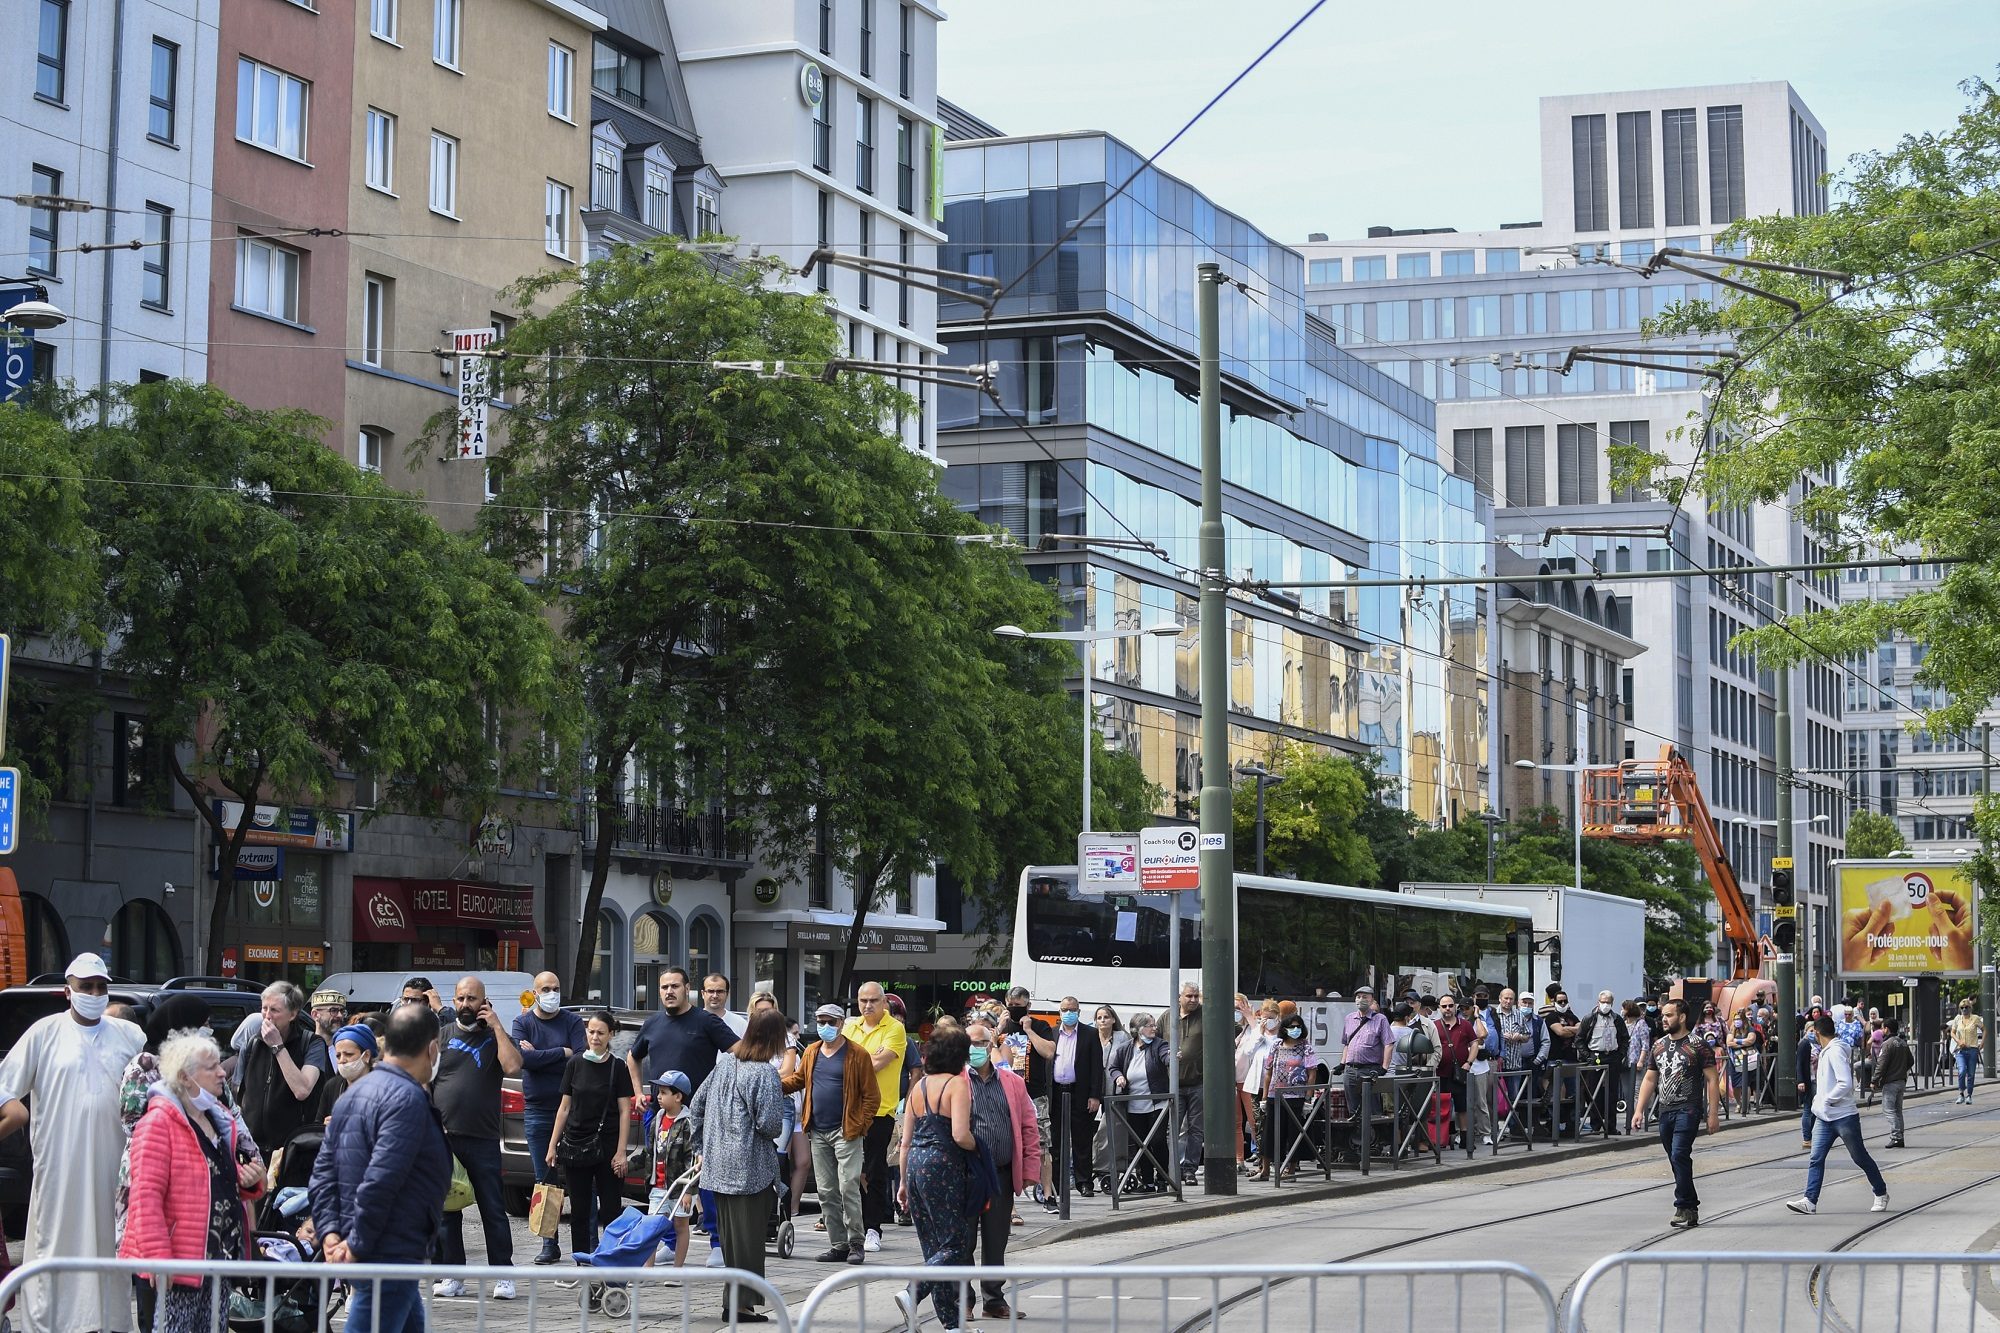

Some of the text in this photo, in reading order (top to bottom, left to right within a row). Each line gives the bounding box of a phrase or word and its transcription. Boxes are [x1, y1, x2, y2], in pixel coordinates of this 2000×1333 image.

[808, 73, 822, 93] B&B
[461, 358, 472, 406] EURO
[1162, 837, 1176, 845] Stop
[659, 879, 672, 892] B&B
[1907, 882, 1927, 899] 50
[413, 889, 452, 911] HOTEL
[462, 894, 487, 913] EURO
[487, 895, 514, 916] CAPITAL
[376, 903, 395, 917] €C
[377, 916, 402, 928] HOTEL
[797, 931, 831, 941] STELLA ARTOIS
[894, 934, 925, 944] CUCINA ITALIANA
[1867, 933, 1948, 950] Protégeons-nous
[432, 947, 446, 955] HOTEL
[890, 943, 909, 952] BRASSERIE
[912, 944, 929, 953] PIZZERIA
[248, 948, 279, 960] EXCHANGE
[1040, 955, 1093, 963] INTOURO
[413, 956, 465, 966] EURO CAPITAL BRUSSELS
[1917, 960, 1928, 968] vies
[893, 981, 918, 991] Factory
[953, 981, 987, 992] FOOD
